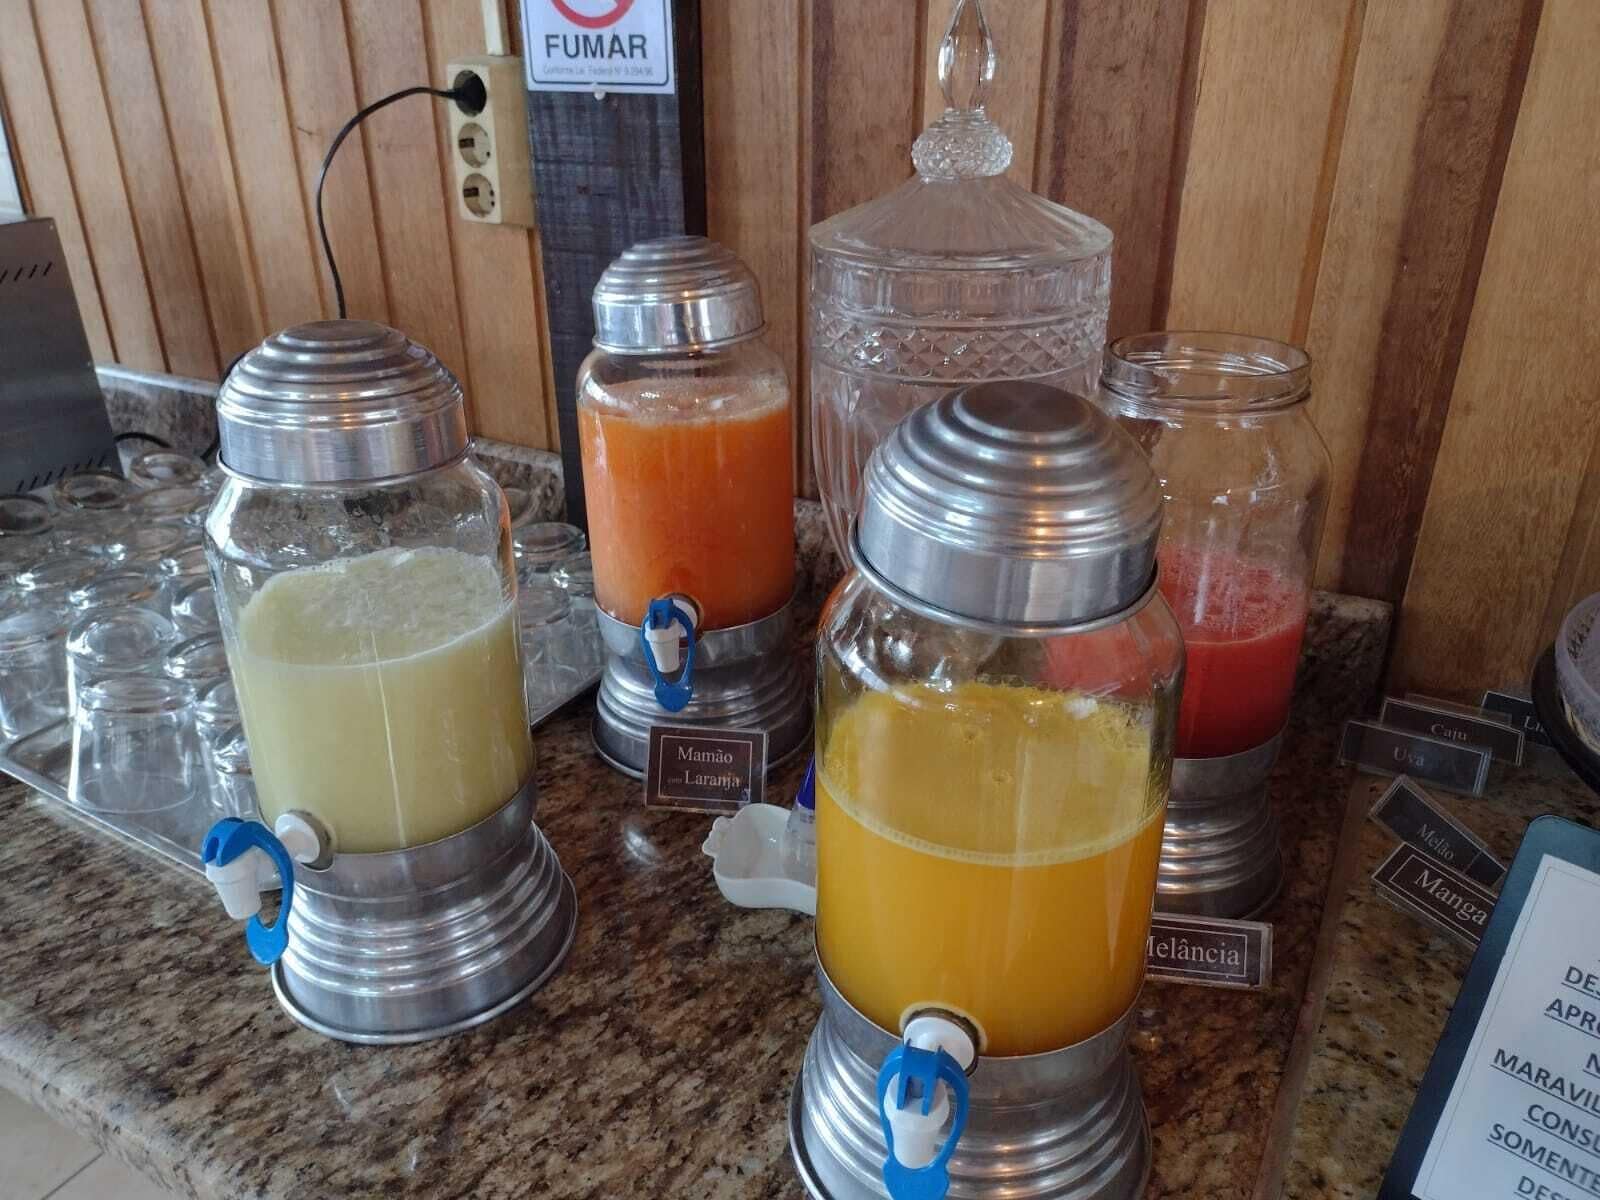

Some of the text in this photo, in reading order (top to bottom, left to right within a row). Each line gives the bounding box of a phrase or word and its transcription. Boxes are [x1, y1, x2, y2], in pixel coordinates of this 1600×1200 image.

[545, 33, 648, 60] FUMAR
[1430, 723, 1467, 742] Caju
[678, 745, 733, 764] Mamão
[1393, 746, 1425, 768] Uva
[684, 769, 740, 791] Laranja
[1416, 823, 1454, 862] Melão
[1413, 868, 1488, 927] Manga
[1564, 965, 1600, 997] DE
[1545, 998, 1600, 1036] APR
